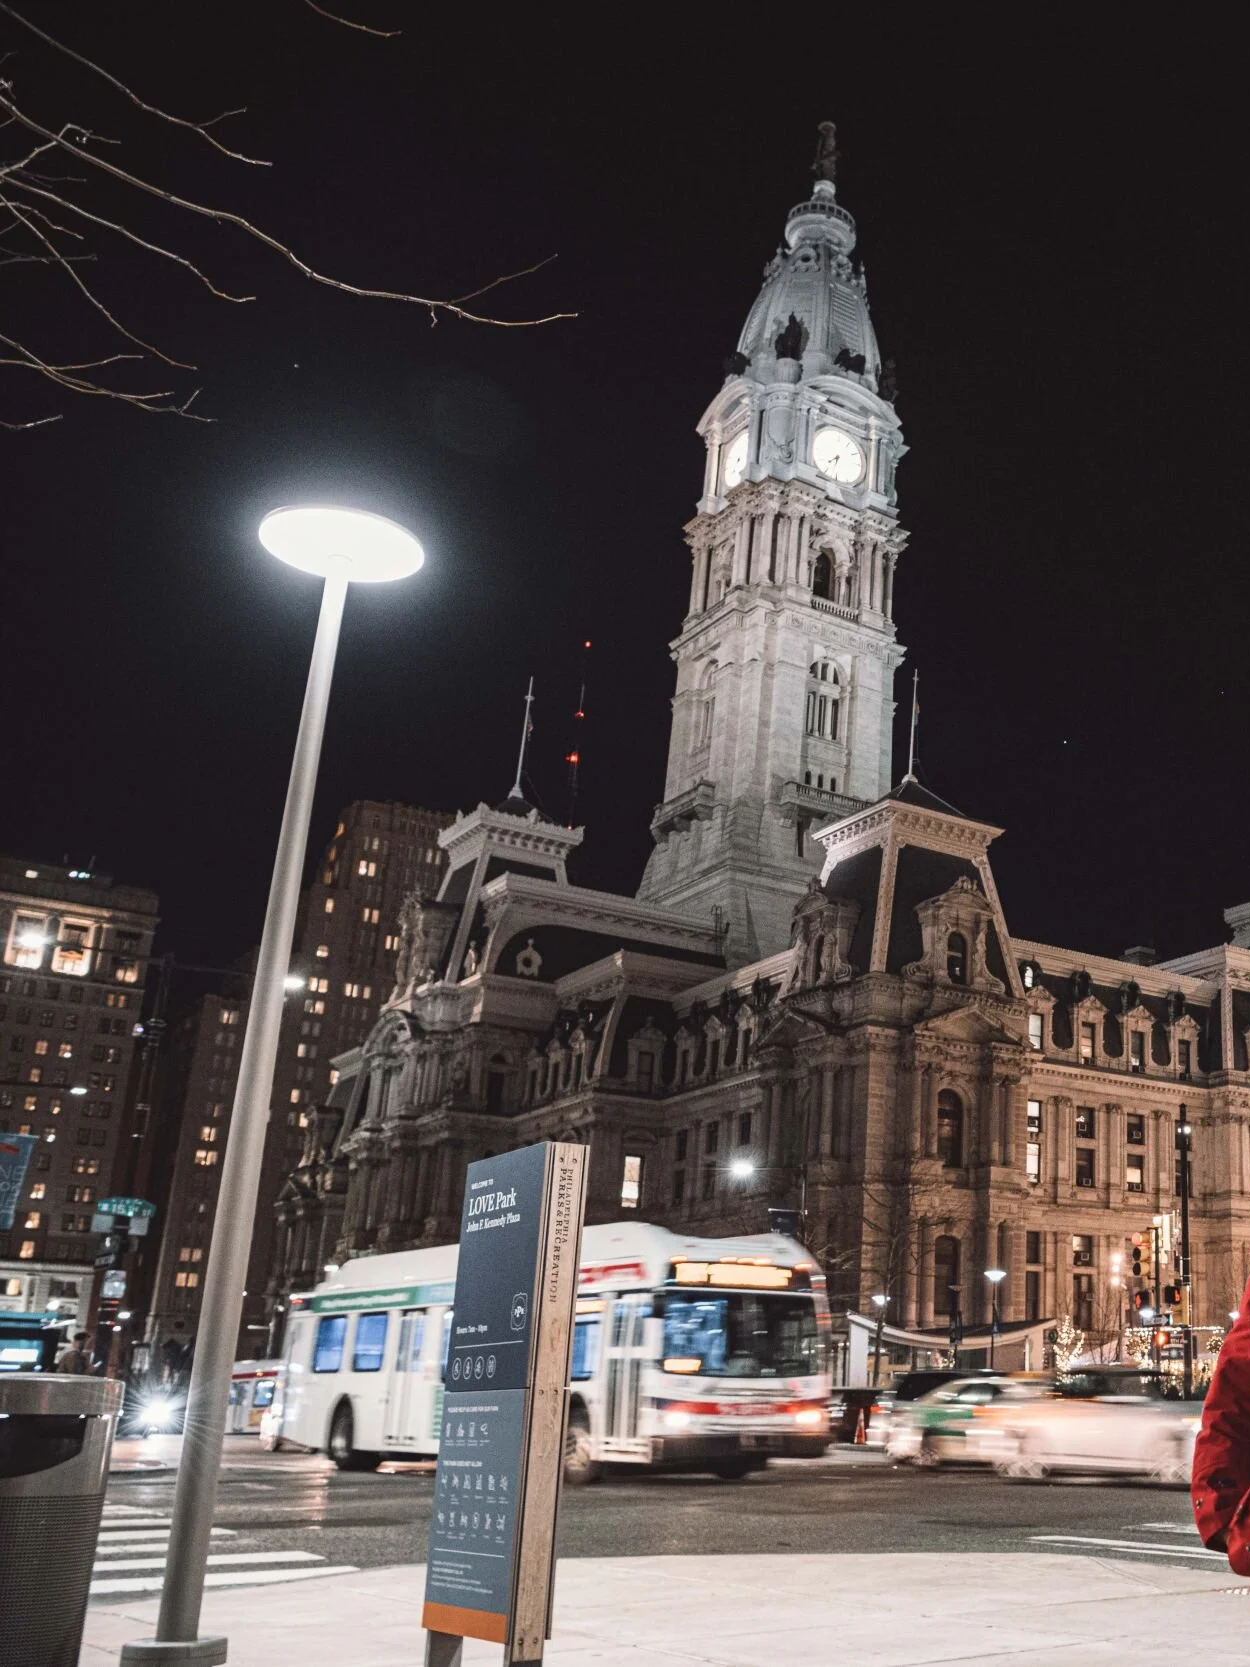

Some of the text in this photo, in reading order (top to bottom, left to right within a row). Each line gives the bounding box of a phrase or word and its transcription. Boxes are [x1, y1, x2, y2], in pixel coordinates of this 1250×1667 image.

[468, 1187, 517, 1217] LOVE Park
[557, 1168, 567, 1208] PARKS
[562, 1168, 574, 1244] PHILADELPHIA
[466, 1221, 479, 1233] John
[484, 1214, 506, 1228] Kennedy
[506, 1212, 521, 1224] Plaza
[550, 1220, 563, 1303] RECREATION
